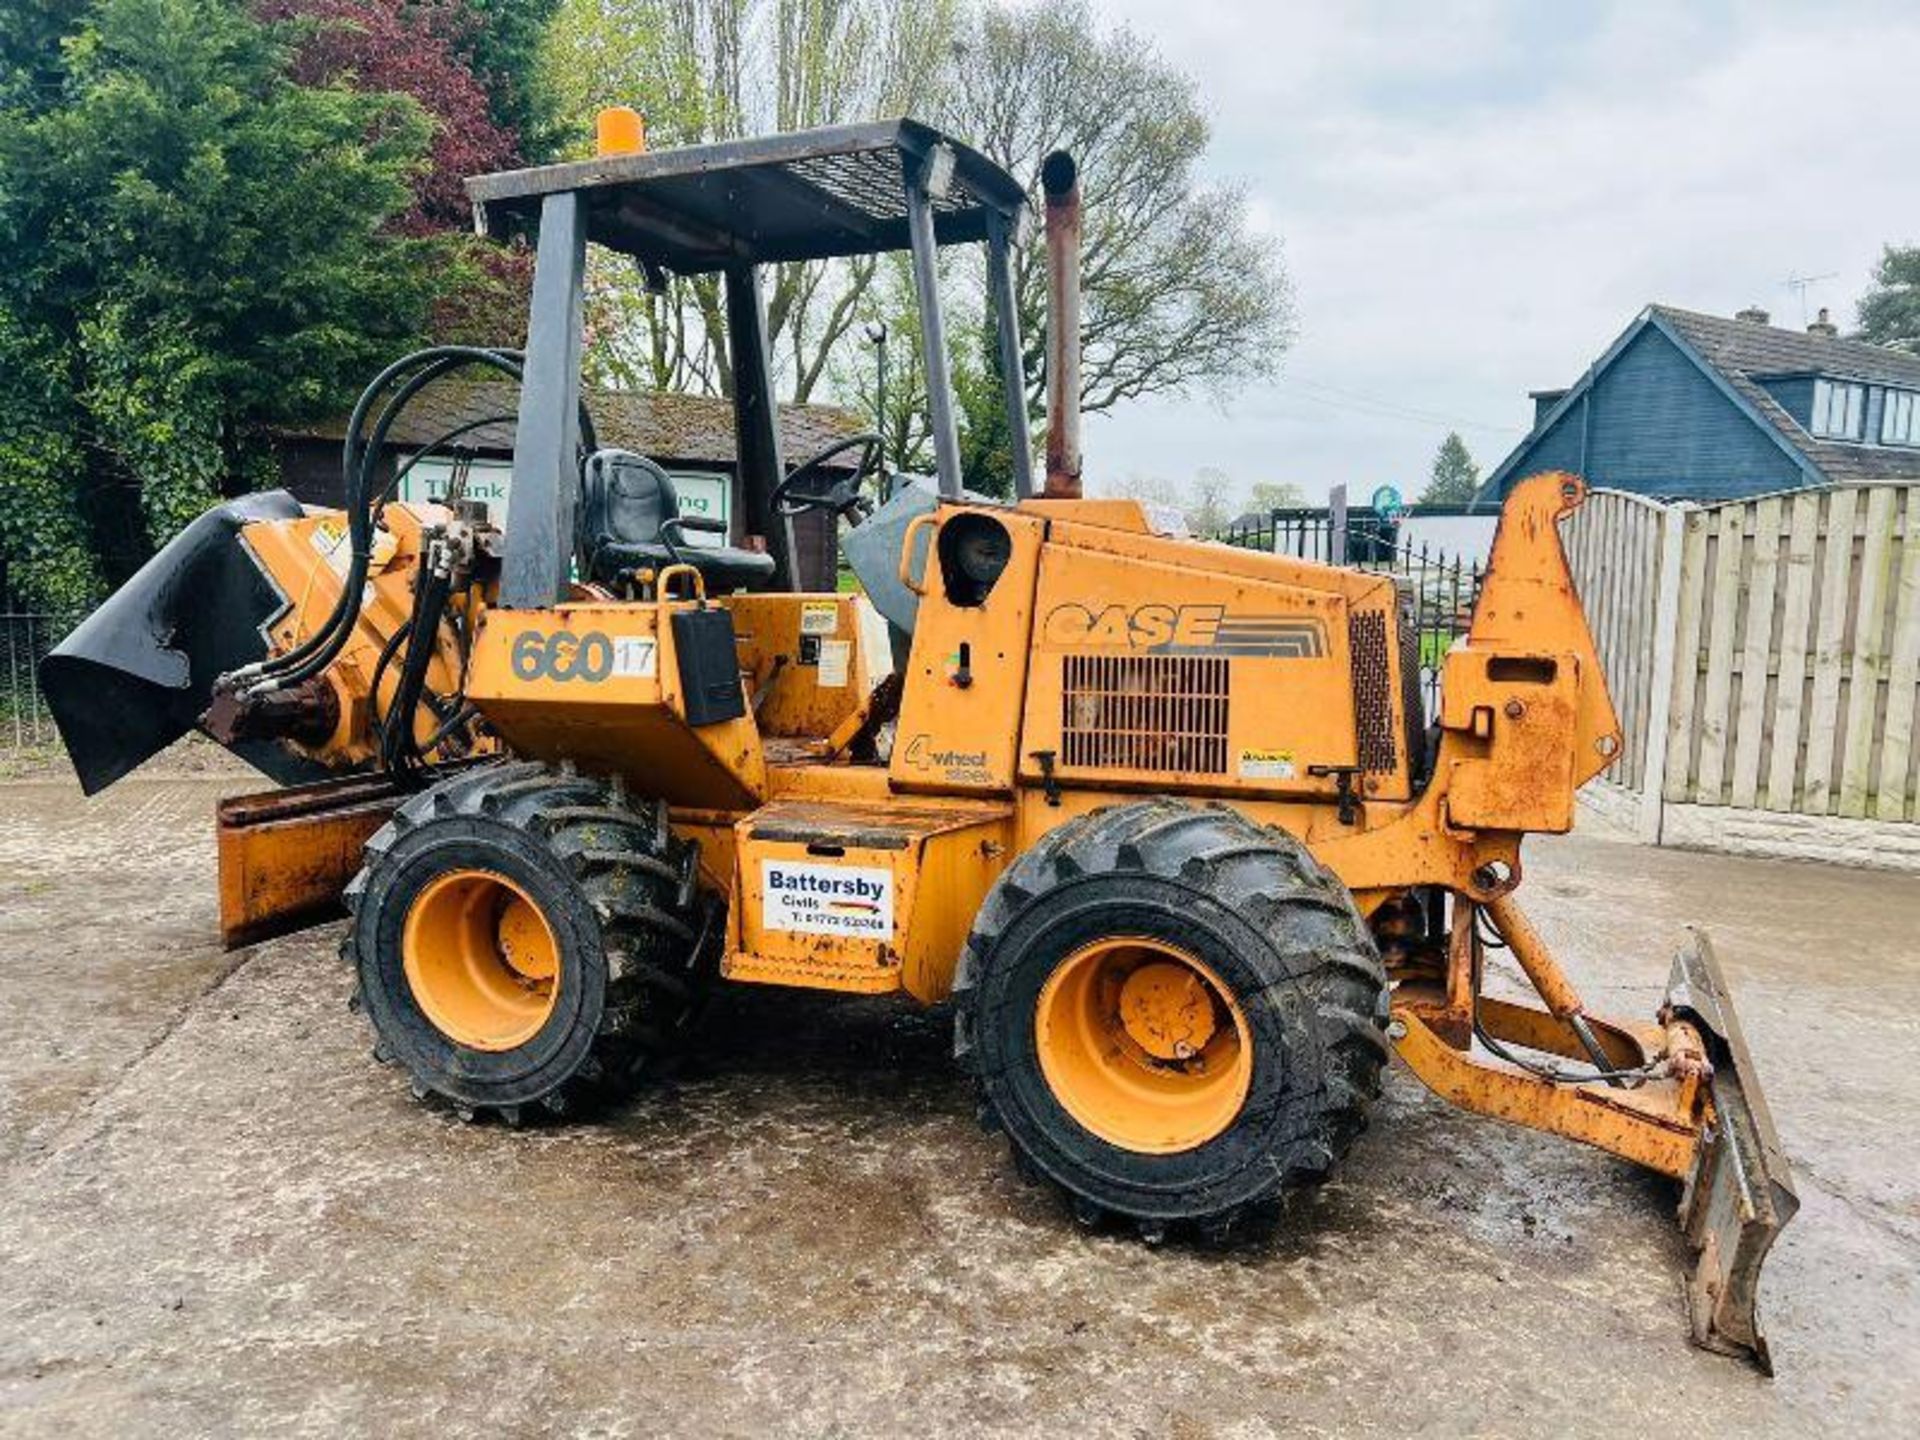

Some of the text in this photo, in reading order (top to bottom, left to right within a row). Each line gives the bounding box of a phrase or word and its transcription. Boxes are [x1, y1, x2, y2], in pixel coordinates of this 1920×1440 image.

[1044, 602, 1226, 648] CASE
[511, 630, 615, 683] 660
[618, 641, 655, 673] 17
[931, 750, 987, 767] wheel
[769, 870, 884, 901] Battersby
[781, 894, 820, 909] Civils
